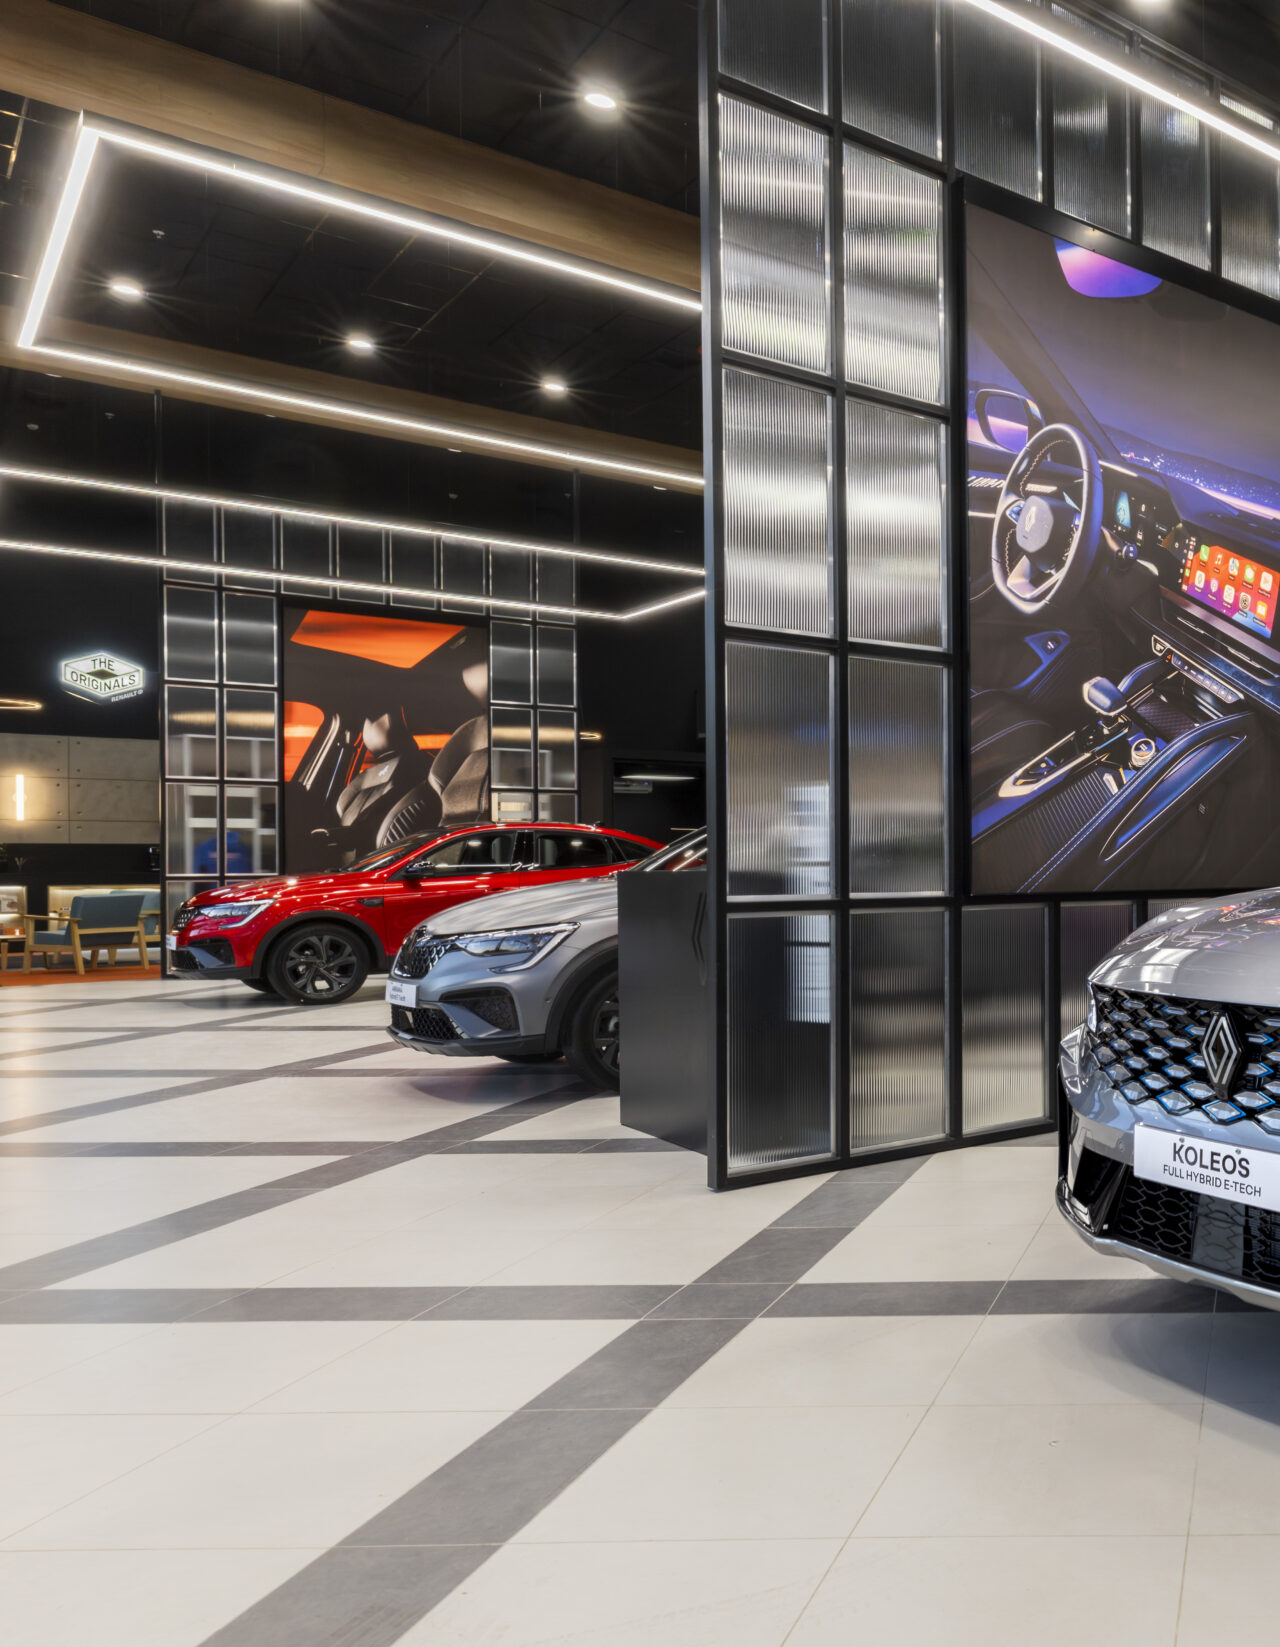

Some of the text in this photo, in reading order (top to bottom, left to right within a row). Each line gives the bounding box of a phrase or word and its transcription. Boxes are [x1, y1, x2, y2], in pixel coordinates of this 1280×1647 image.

[91, 658, 115, 672] THE
[70, 671, 136, 692] ORIGINALS
[111, 690, 138, 703] RENAULT
[1172, 1142, 1250, 1179] KOLEOS
[1163, 1164, 1262, 1198] FULL HYBRID E-TECH
